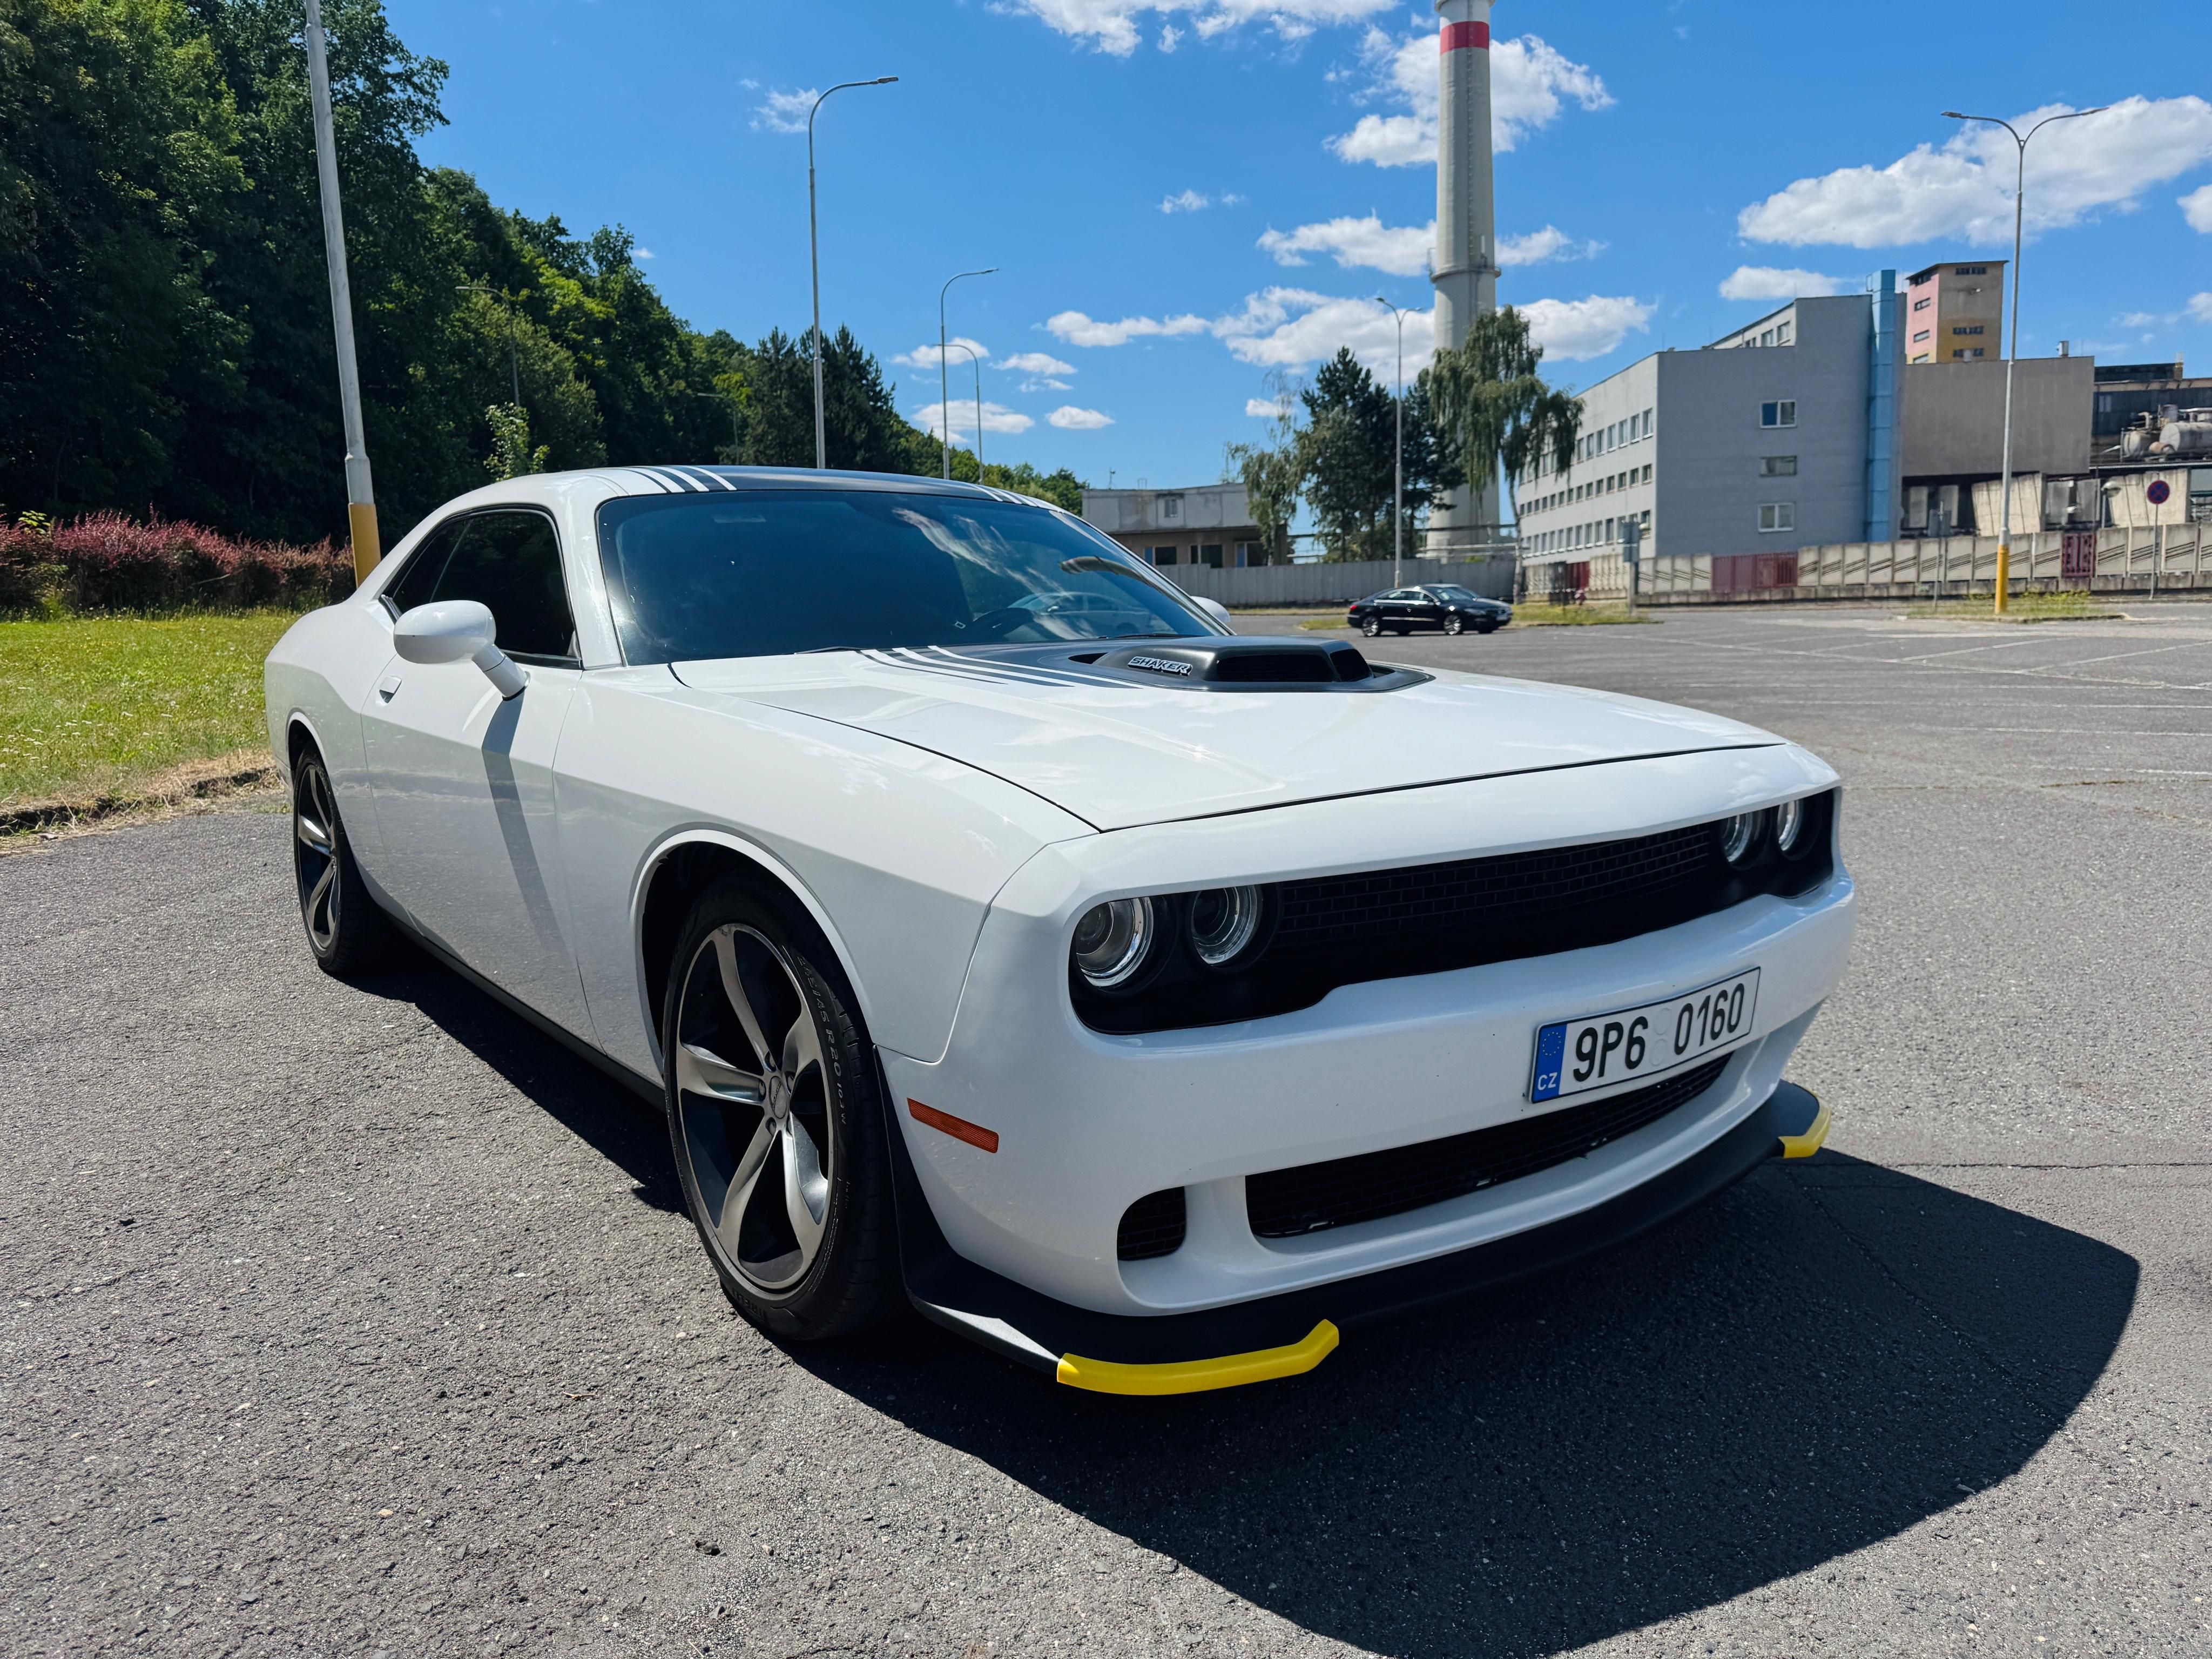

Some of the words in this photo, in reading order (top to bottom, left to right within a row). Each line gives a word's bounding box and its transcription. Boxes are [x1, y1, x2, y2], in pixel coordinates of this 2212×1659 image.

[1129, 657, 1190, 672] SHAKER
[1573, 1016, 1648, 1082] 9P6
[1674, 983, 1745, 1055] 0160
[1537, 1071, 1558, 1091] CZ
